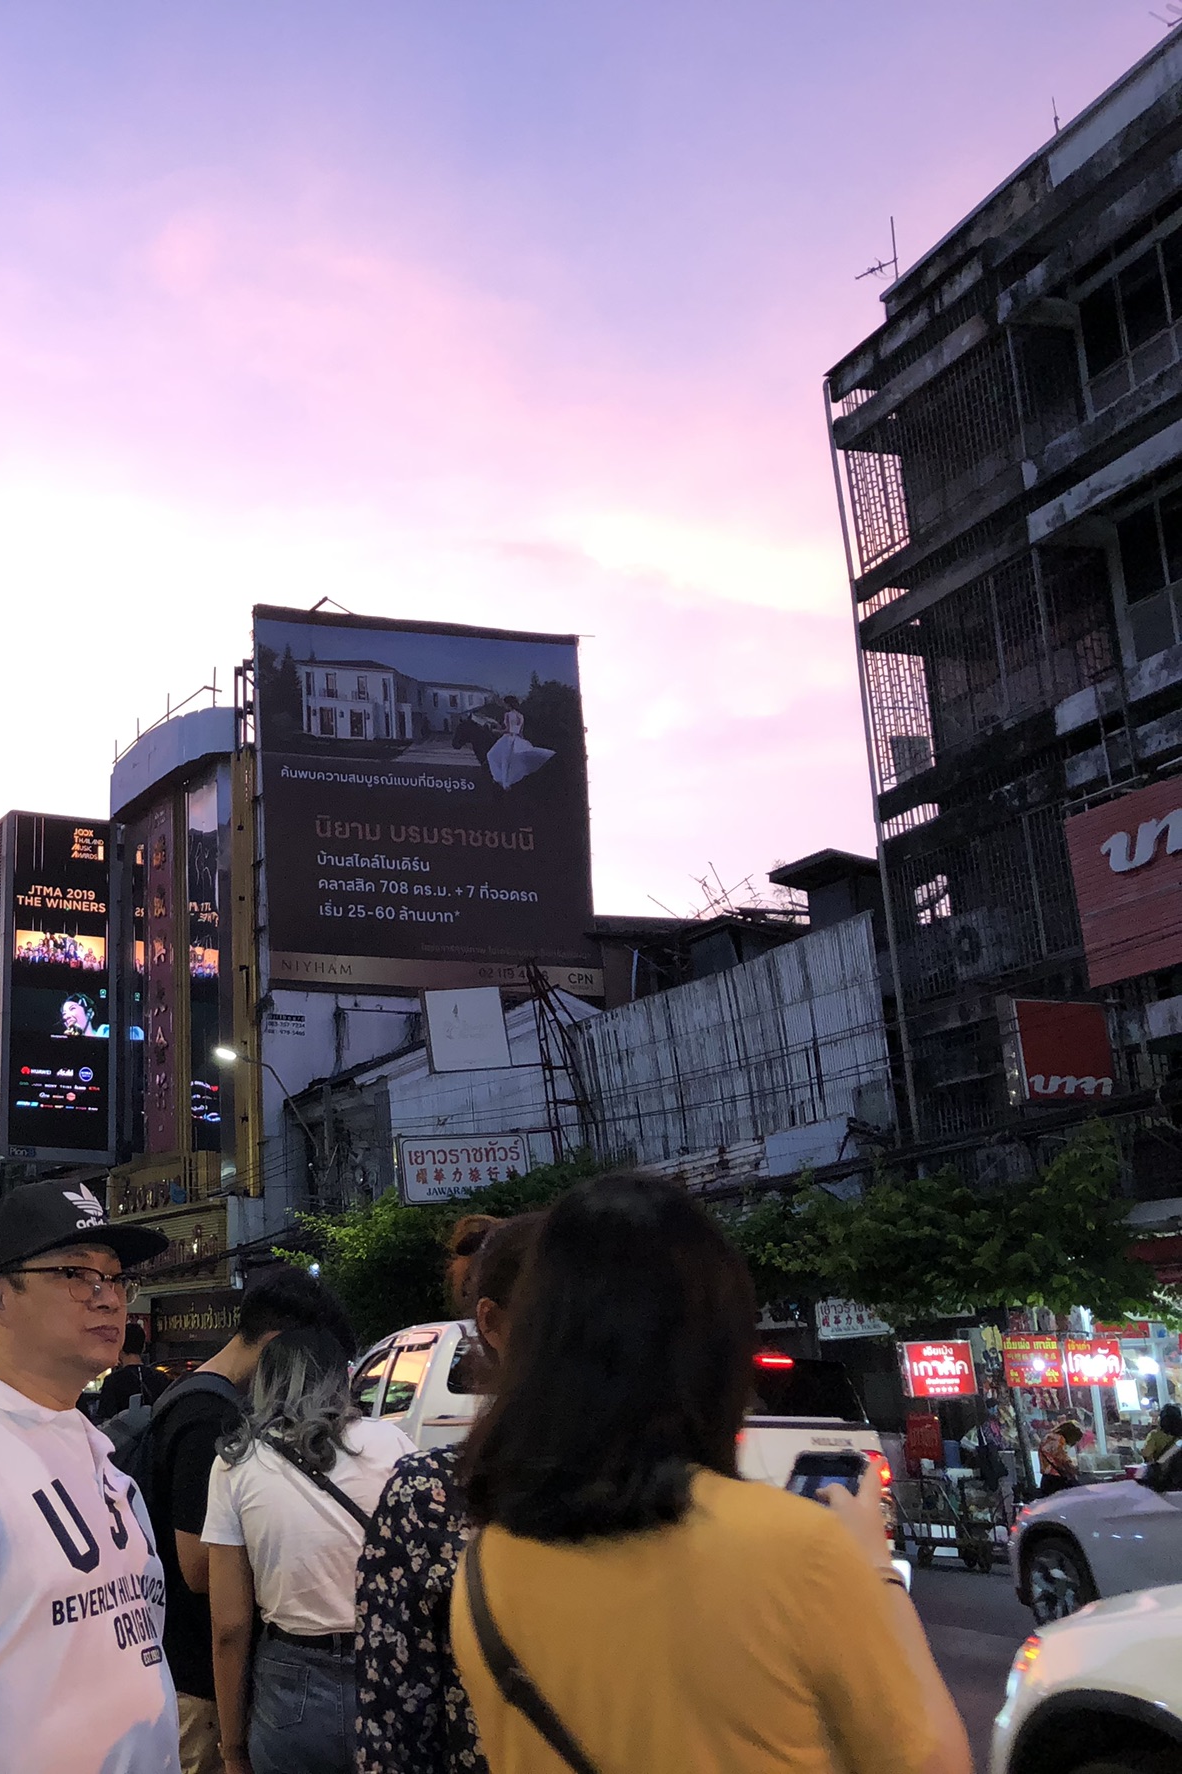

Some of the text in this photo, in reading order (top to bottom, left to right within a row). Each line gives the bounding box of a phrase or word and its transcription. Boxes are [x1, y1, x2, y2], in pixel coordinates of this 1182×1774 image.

[281, 766, 475, 792] ค้นพบความสมบูรณ์แบบที่มีอยู่จริง
[315, 815, 535, 850] นิยาม บรมราชชนนี
[317, 850, 431, 872] บ้านสไตล์โมเดิร์น
[28, 885, 96, 900] JTMA 2019
[379, 880, 409, 895] 708
[413, 884, 452, 898] ตร.ม.
[467, 885, 475, 898] 7
[479, 882, 538, 902] ที่จอดรถ
[17, 895, 106, 913] THE WINNERS
[319, 899, 343, 918] เริ่ม
[347, 904, 396, 919] 25-60
[281, 960, 353, 976] NIYHAM
[568, 973, 594, 986] CPN
[408, 1140, 520, 1166] เยาวราชทัวร์
[52, 1580, 118, 1626] BEVERLY
[113, 1606, 158, 1651] ORIGIN
